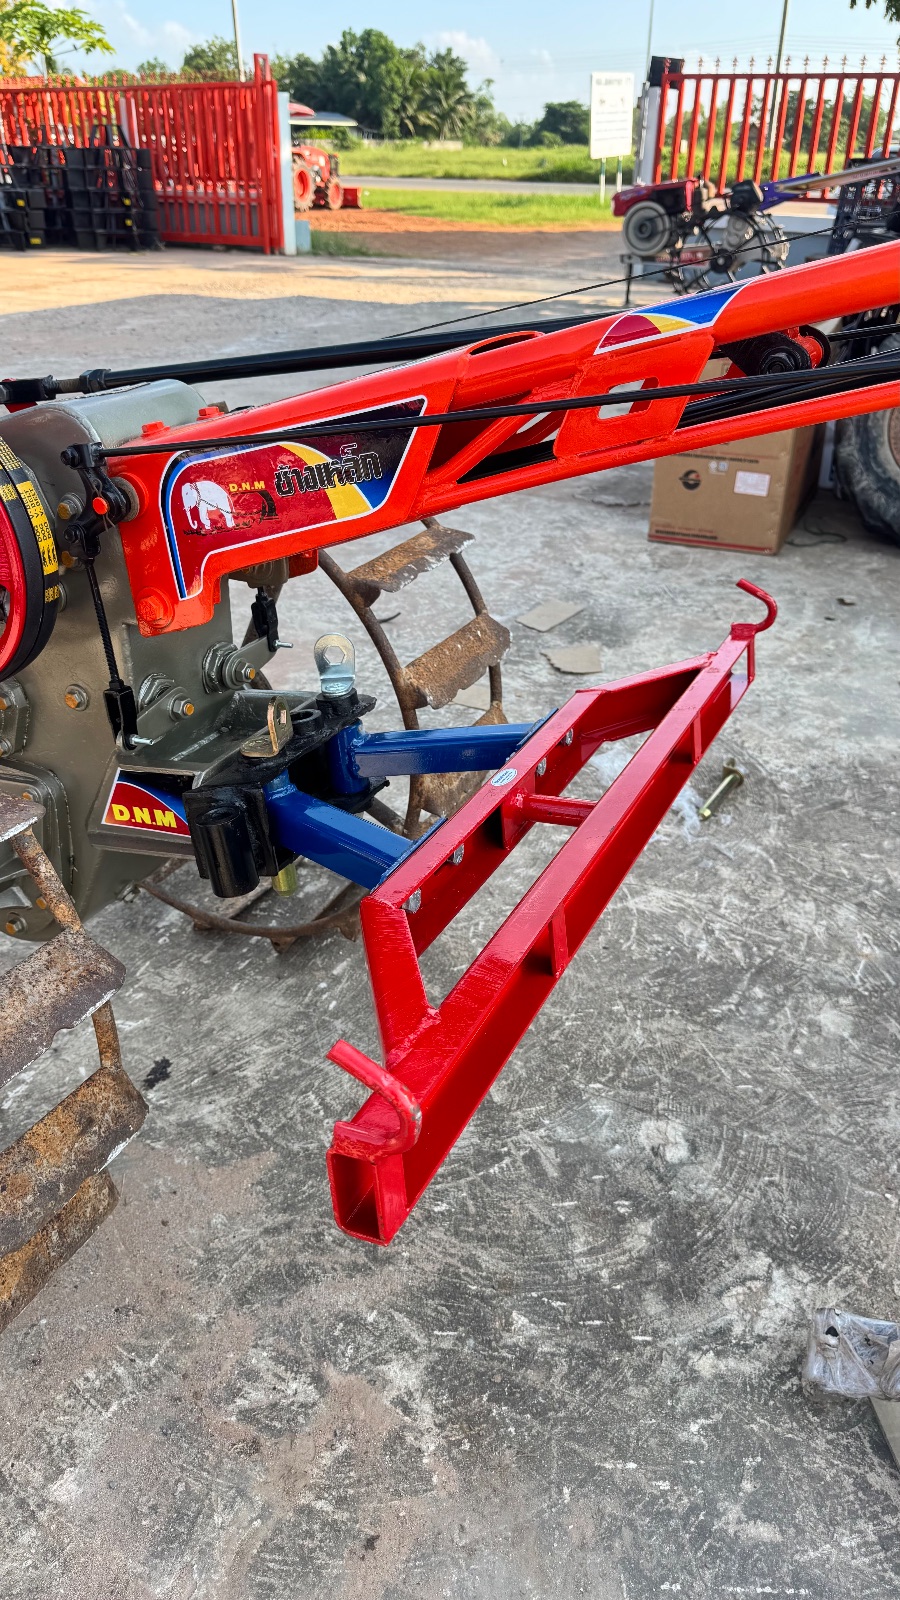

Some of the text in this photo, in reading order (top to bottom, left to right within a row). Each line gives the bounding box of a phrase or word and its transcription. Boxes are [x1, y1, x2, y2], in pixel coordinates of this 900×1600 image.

[274, 443, 382, 497] ช้างเหล็ก
[229, 480, 265, 492] D.N.M
[111, 804, 177, 828] D.N.M
